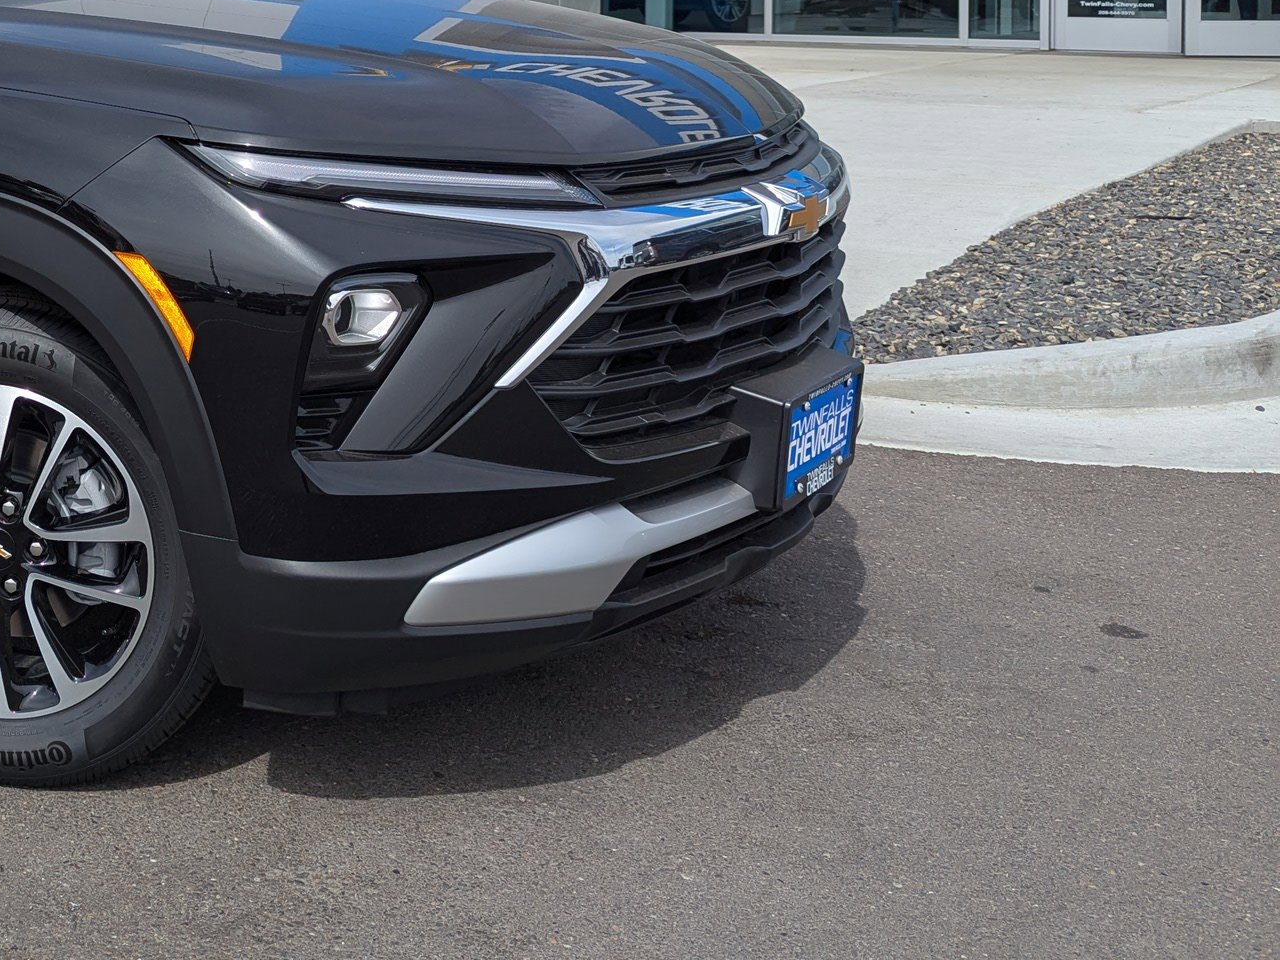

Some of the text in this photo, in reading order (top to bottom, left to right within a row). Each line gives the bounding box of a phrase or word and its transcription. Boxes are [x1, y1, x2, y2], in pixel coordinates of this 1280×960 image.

[792, 389, 854, 439] TWINFALLS
[787, 406, 852, 472] CHEVROLET
[806, 456, 835, 481] TWINFALLS
[806, 467, 834, 497] CHEVROLET
